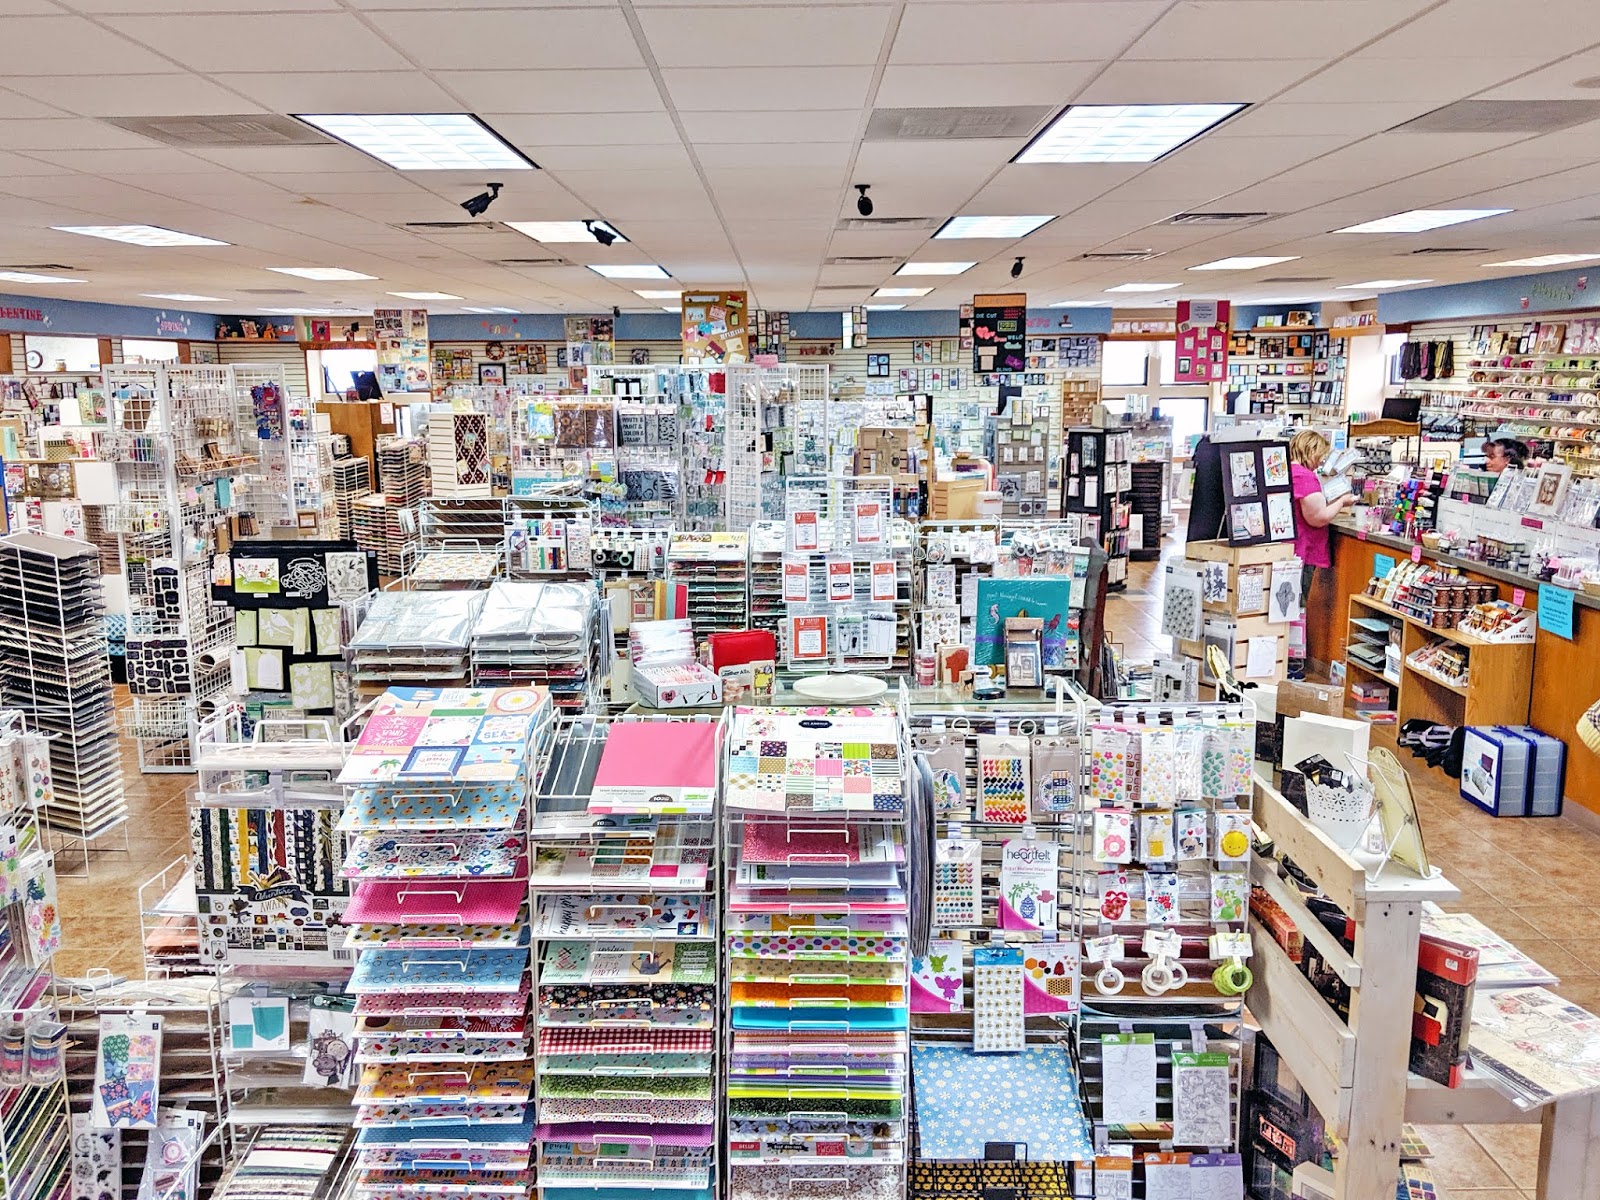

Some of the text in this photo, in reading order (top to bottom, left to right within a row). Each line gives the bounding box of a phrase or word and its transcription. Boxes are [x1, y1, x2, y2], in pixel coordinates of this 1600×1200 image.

[484, 730, 508, 739] SEA
[1006, 848, 1051, 861] heartfelt
[255, 887, 298, 901] Adventure
[401, 1017, 431, 1026] RELAX
